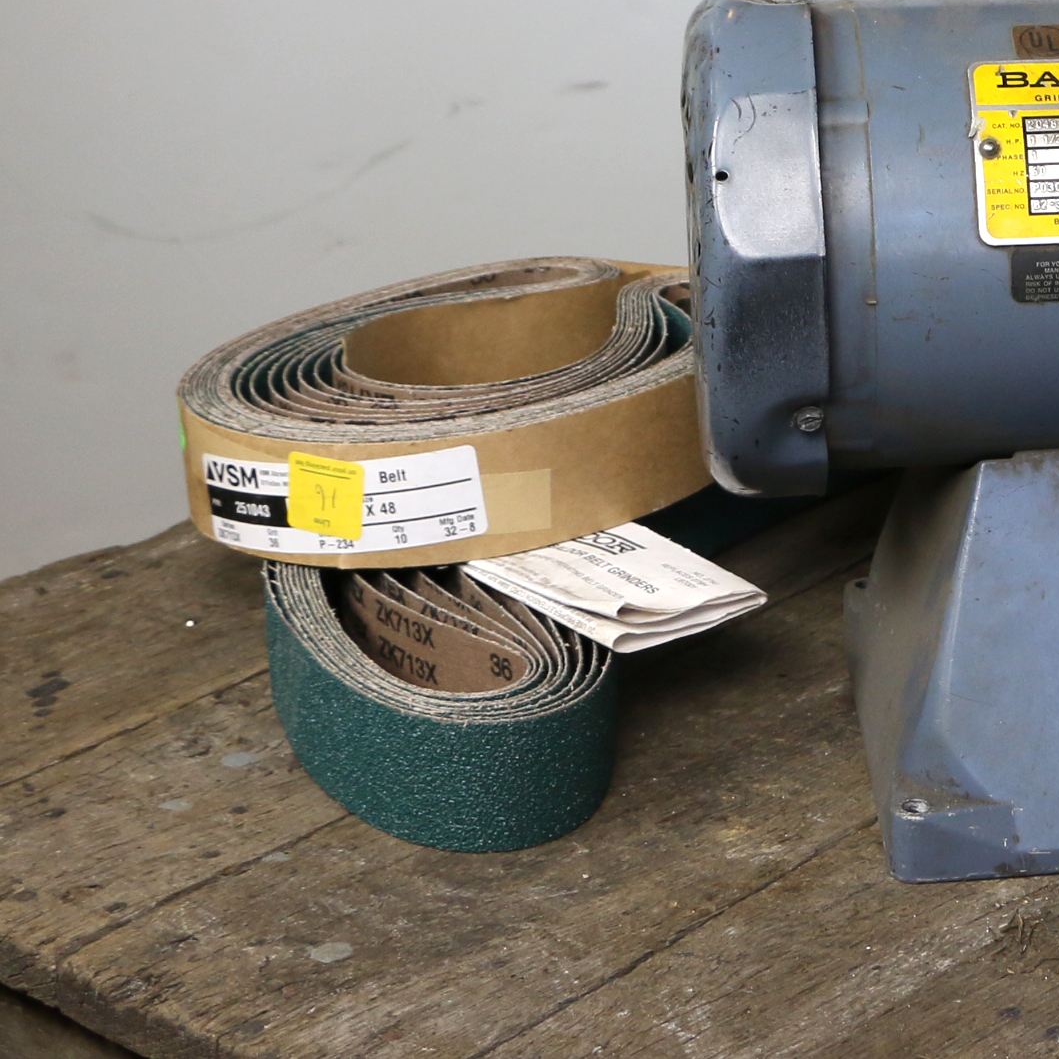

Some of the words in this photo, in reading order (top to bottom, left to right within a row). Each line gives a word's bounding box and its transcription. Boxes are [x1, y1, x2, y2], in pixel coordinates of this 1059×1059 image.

[1030, 135, 1037, 145] 1
[1031, 150, 1038, 160] 1
[211, 460, 259, 489] VSM
[379, 469, 407, 484] Belt
[365, 504, 375, 517] X
[380, 501, 397, 515] 48
[439, 517, 454, 526] Mfg
[457, 513, 475, 523] Date
[392, 525, 405, 534] Qty
[395, 533, 408, 544] 10
[583, 552, 613, 569] BELT
[607, 566, 660, 594] GRINDERS
[375, 599, 435, 650] ZK713X
[378, 635, 439, 686] ZK713X
[489, 652, 513, 682] 36
